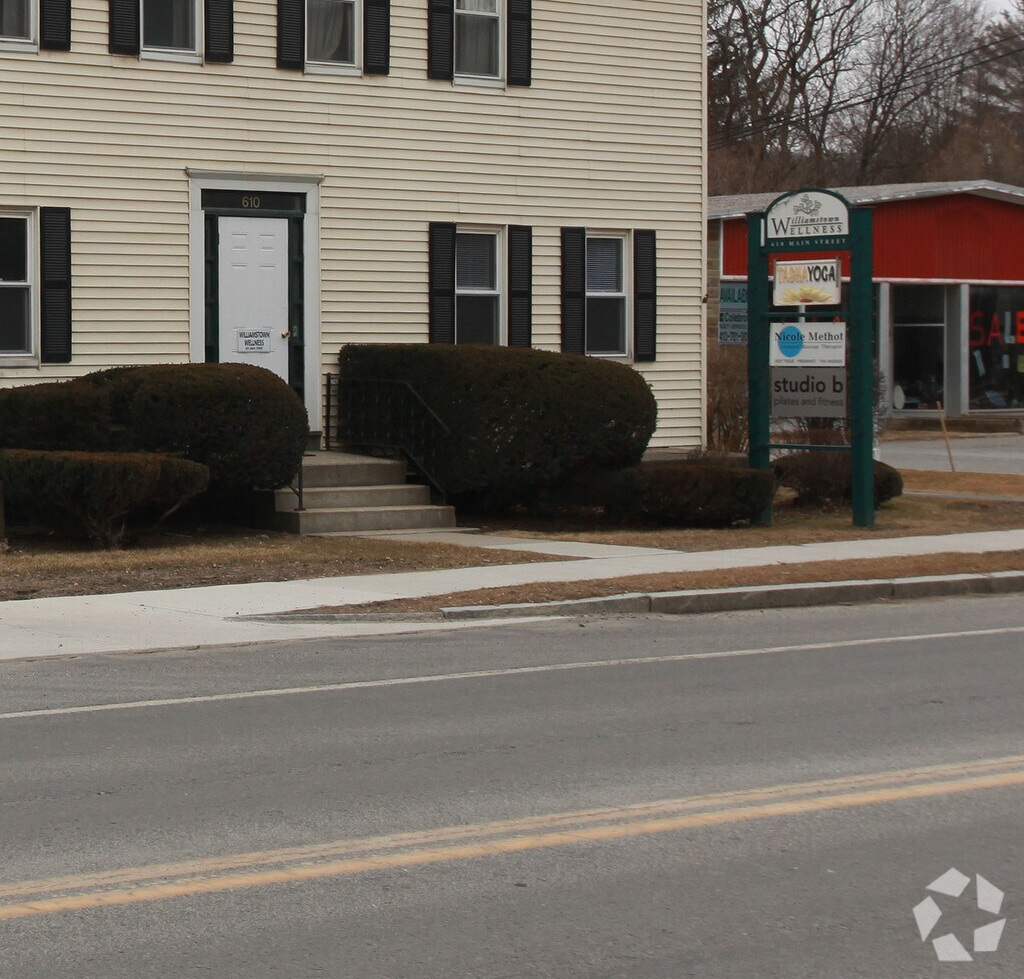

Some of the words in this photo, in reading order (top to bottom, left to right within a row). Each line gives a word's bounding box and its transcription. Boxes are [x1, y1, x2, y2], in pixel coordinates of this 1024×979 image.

[241, 196, 260, 208] 610
[807, 265, 835, 282] YOGA
[969, 311, 1024, 347] SALE
[775, 332, 805, 341] Nicole
[808, 332, 843, 341] Methot
[774, 375, 826, 393] studio
[832, 375, 843, 393] b
[774, 396, 799, 407] pilates
[801, 397, 816, 406] and
[818, 397, 843, 407] fitness
